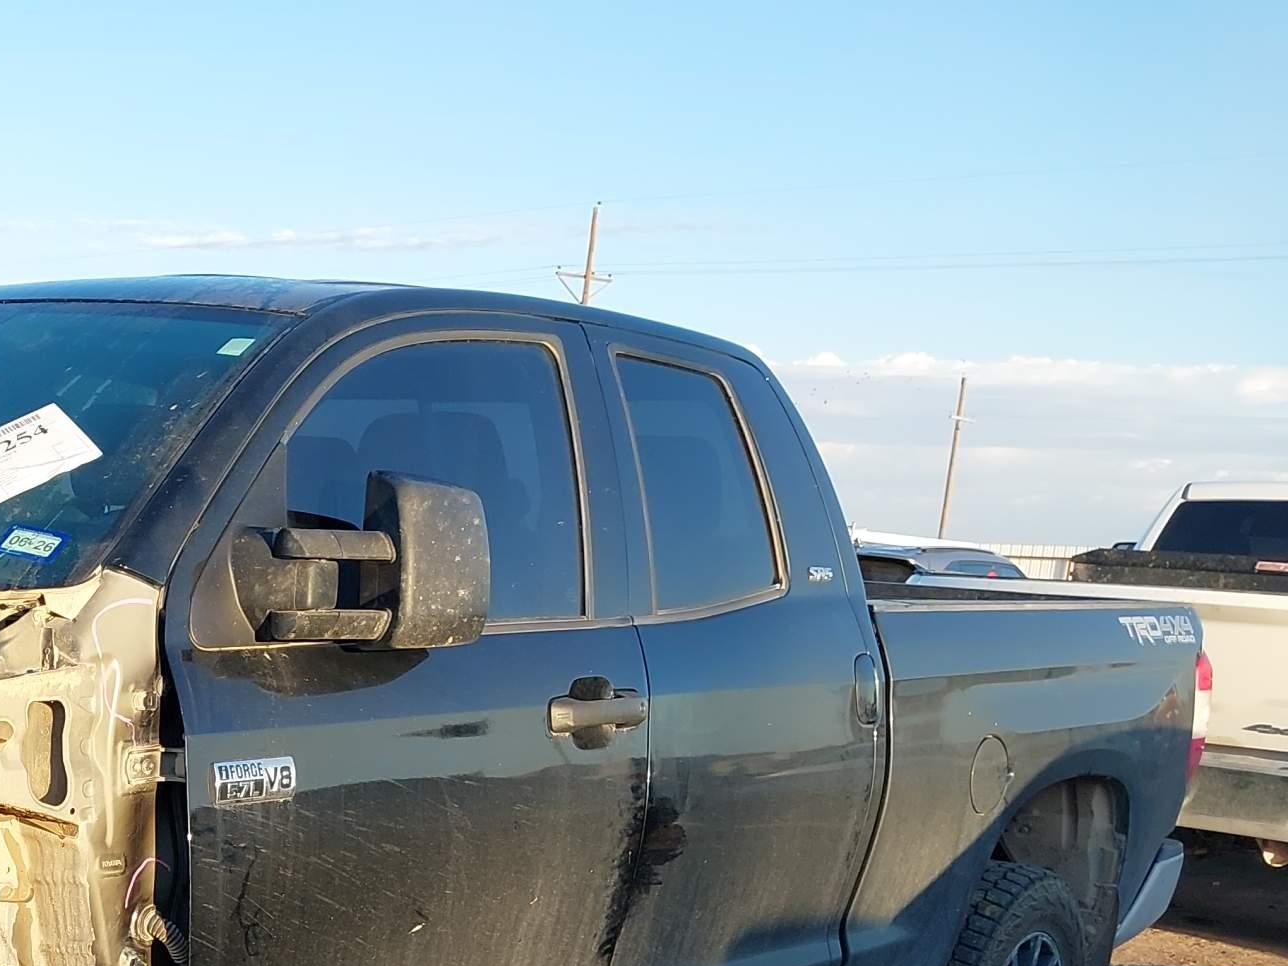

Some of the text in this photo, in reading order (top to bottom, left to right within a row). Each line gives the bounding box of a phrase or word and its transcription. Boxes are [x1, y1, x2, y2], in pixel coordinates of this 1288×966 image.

[9, 535, 55, 553] 06 26
[1118, 616, 1163, 646] TRD
[265, 766, 292, 789] V8
